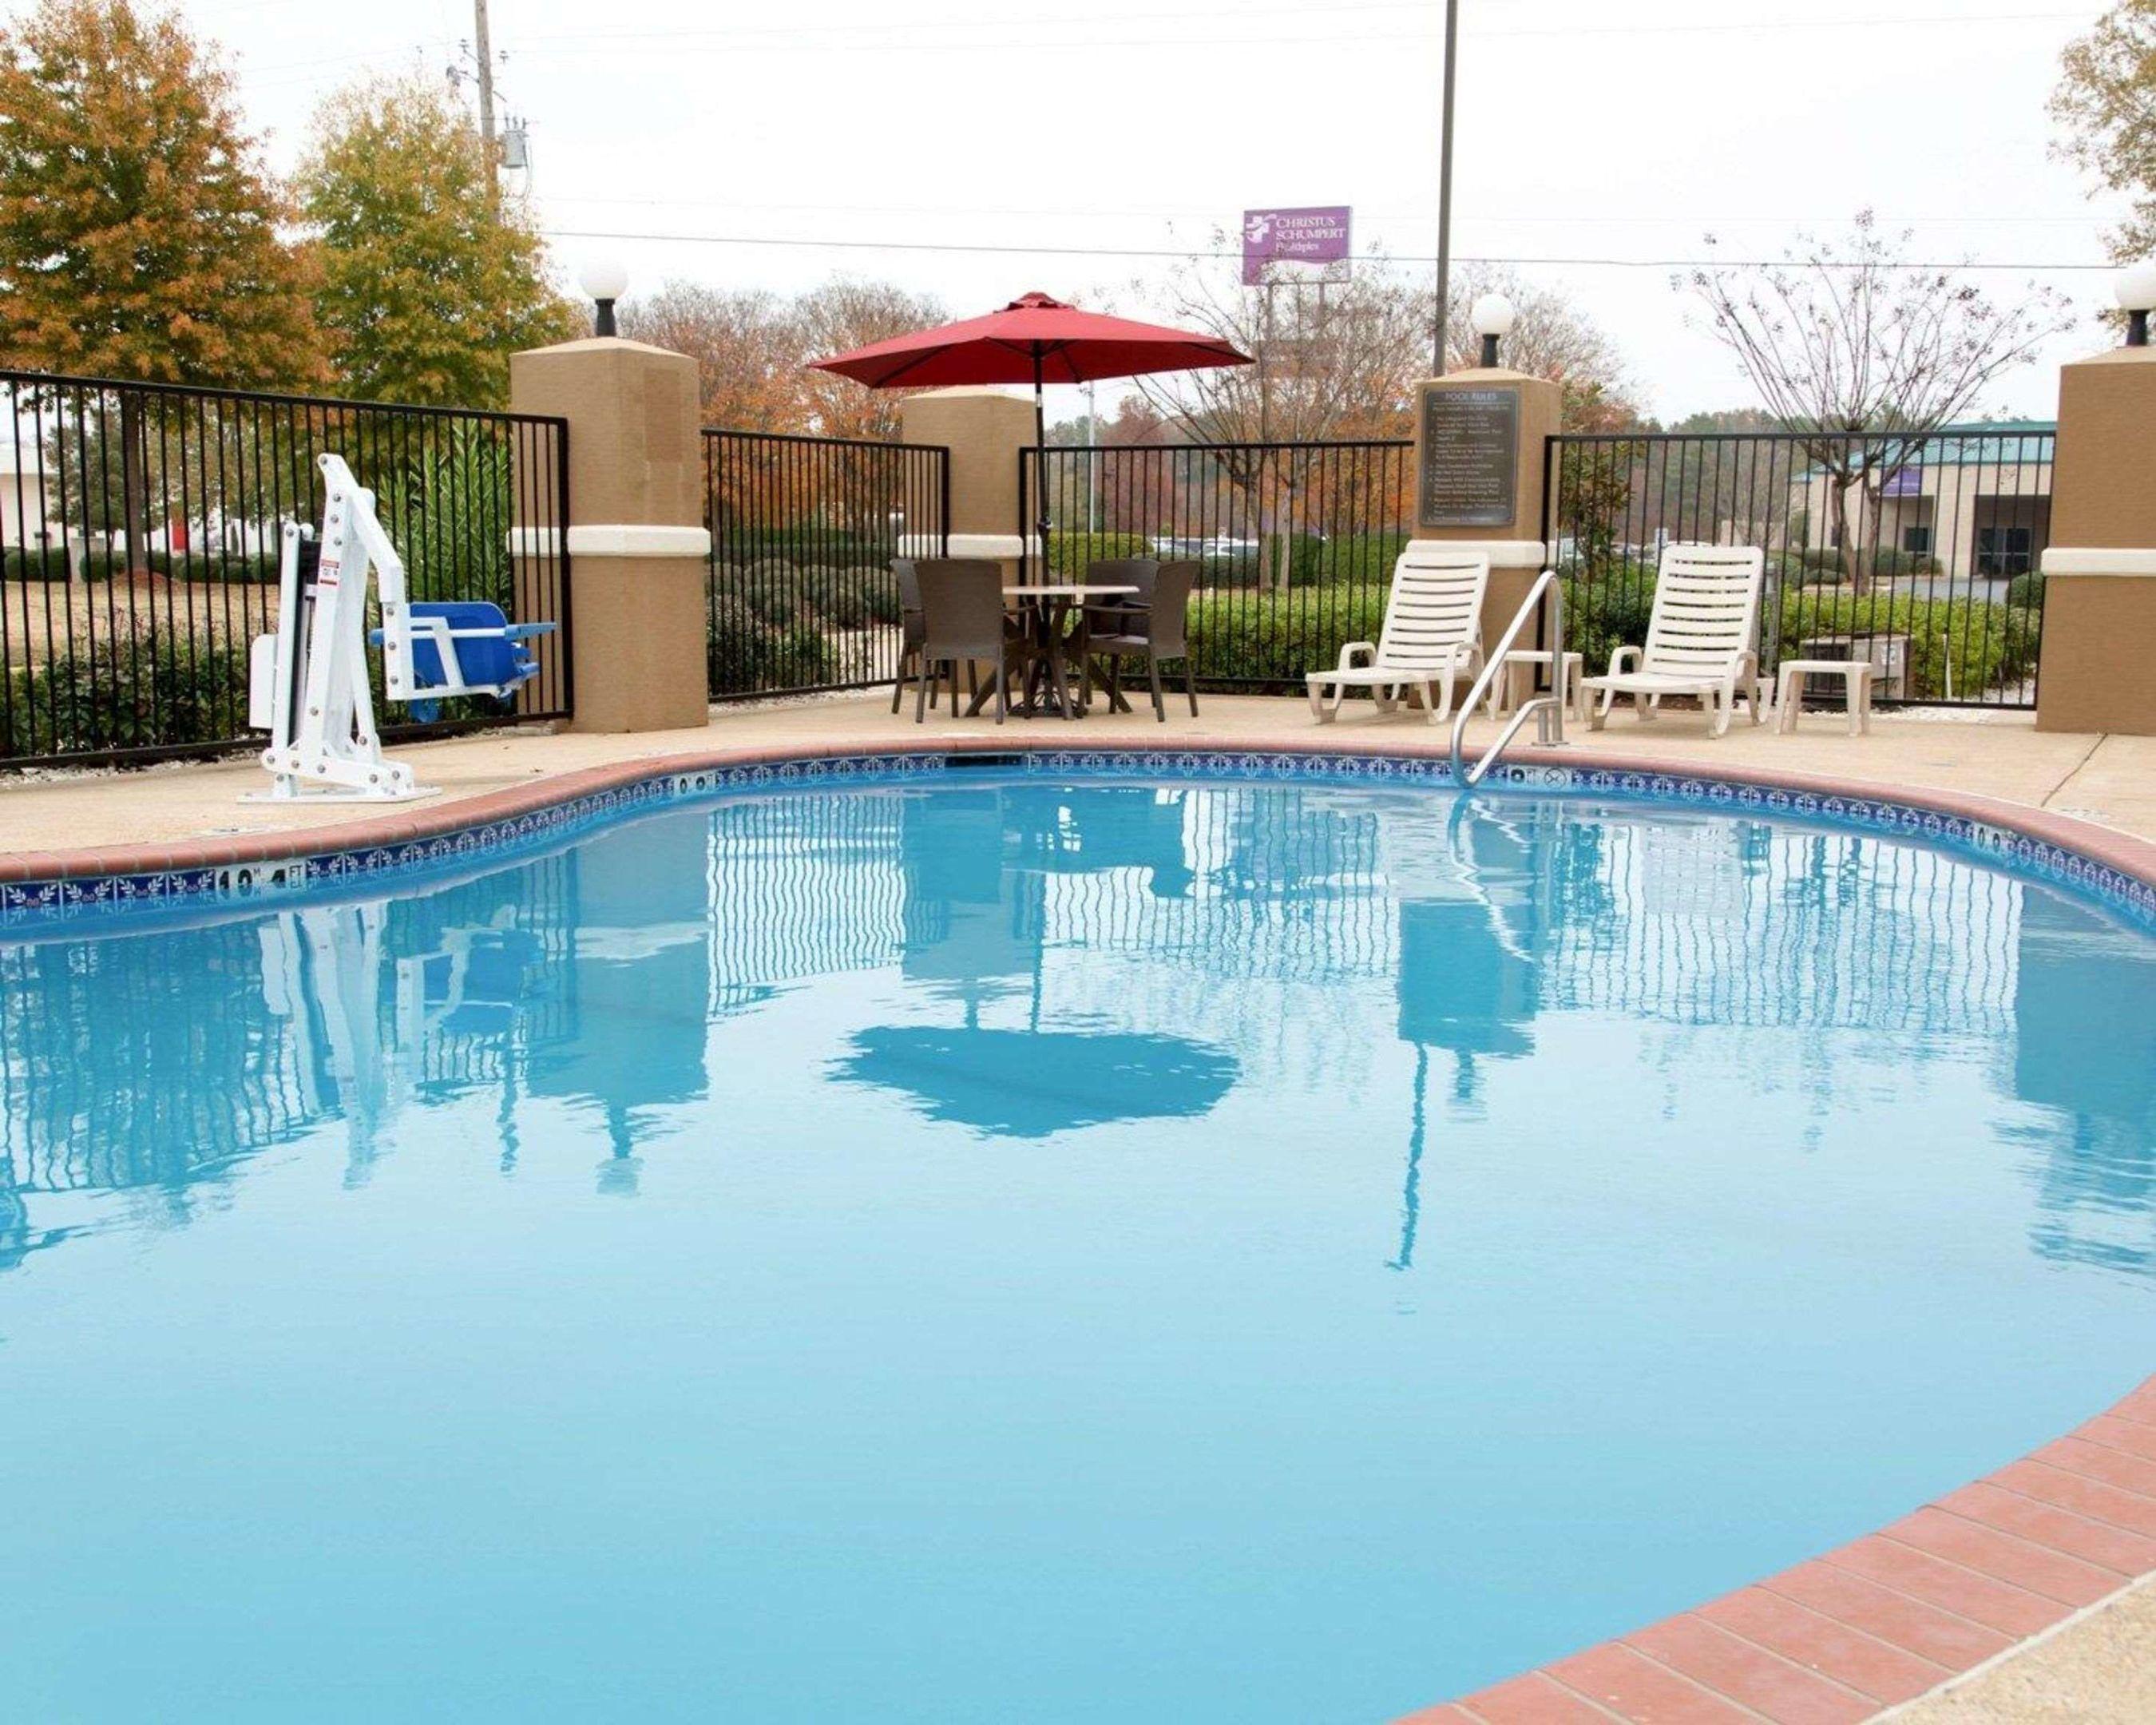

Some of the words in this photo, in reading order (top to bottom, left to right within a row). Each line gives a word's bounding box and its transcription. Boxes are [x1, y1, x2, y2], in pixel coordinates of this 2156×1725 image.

[1276, 216, 1336, 228] CHRISTUS
[1276, 228, 1346, 240] SCHUMPERT
[1471, 391, 1497, 400] RULES
